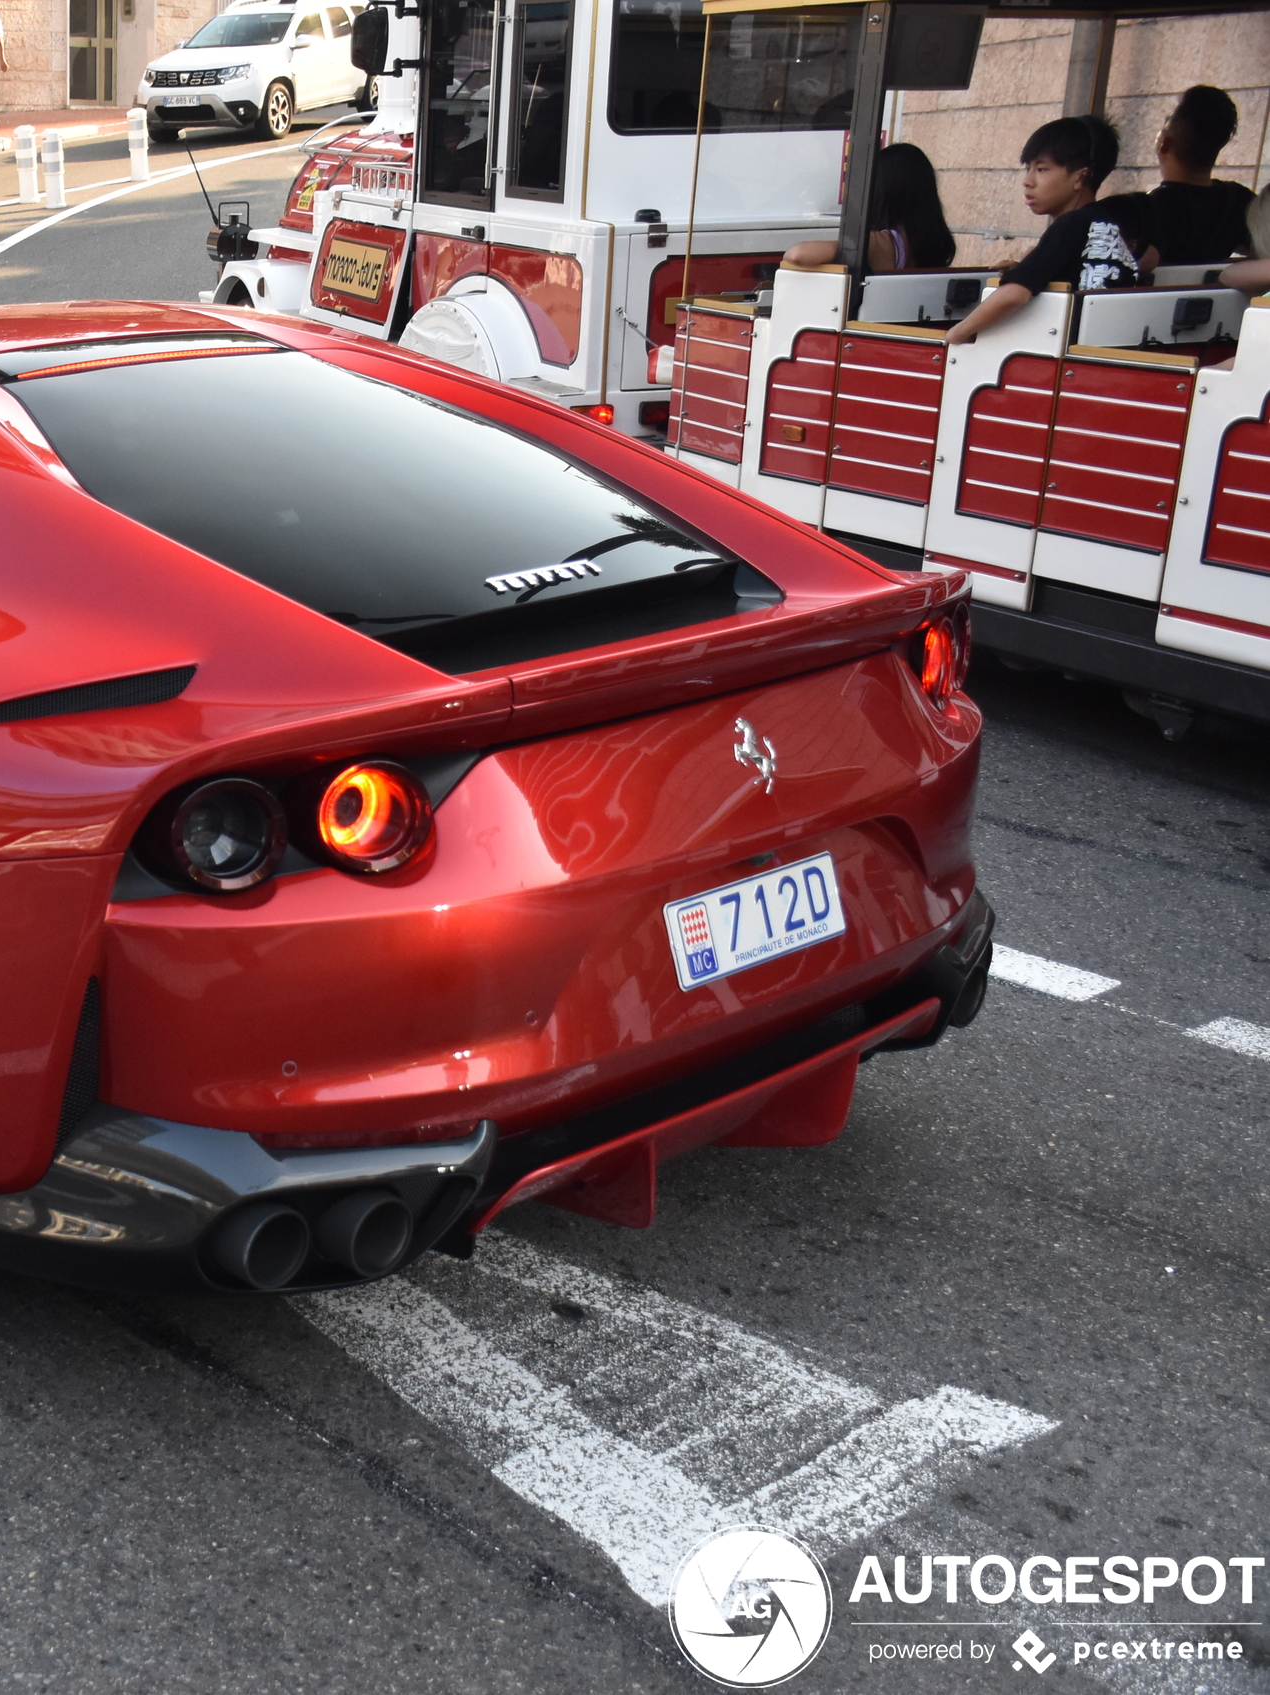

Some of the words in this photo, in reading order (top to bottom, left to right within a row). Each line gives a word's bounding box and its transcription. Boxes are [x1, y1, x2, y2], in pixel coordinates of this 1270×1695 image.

[718, 866, 830, 952] 712D
[692, 951, 713, 974] MC
[734, 939, 783, 964] PRINCIPAUTE
[784, 935, 795, 946] DE
[797, 922, 828, 942] MONACO
